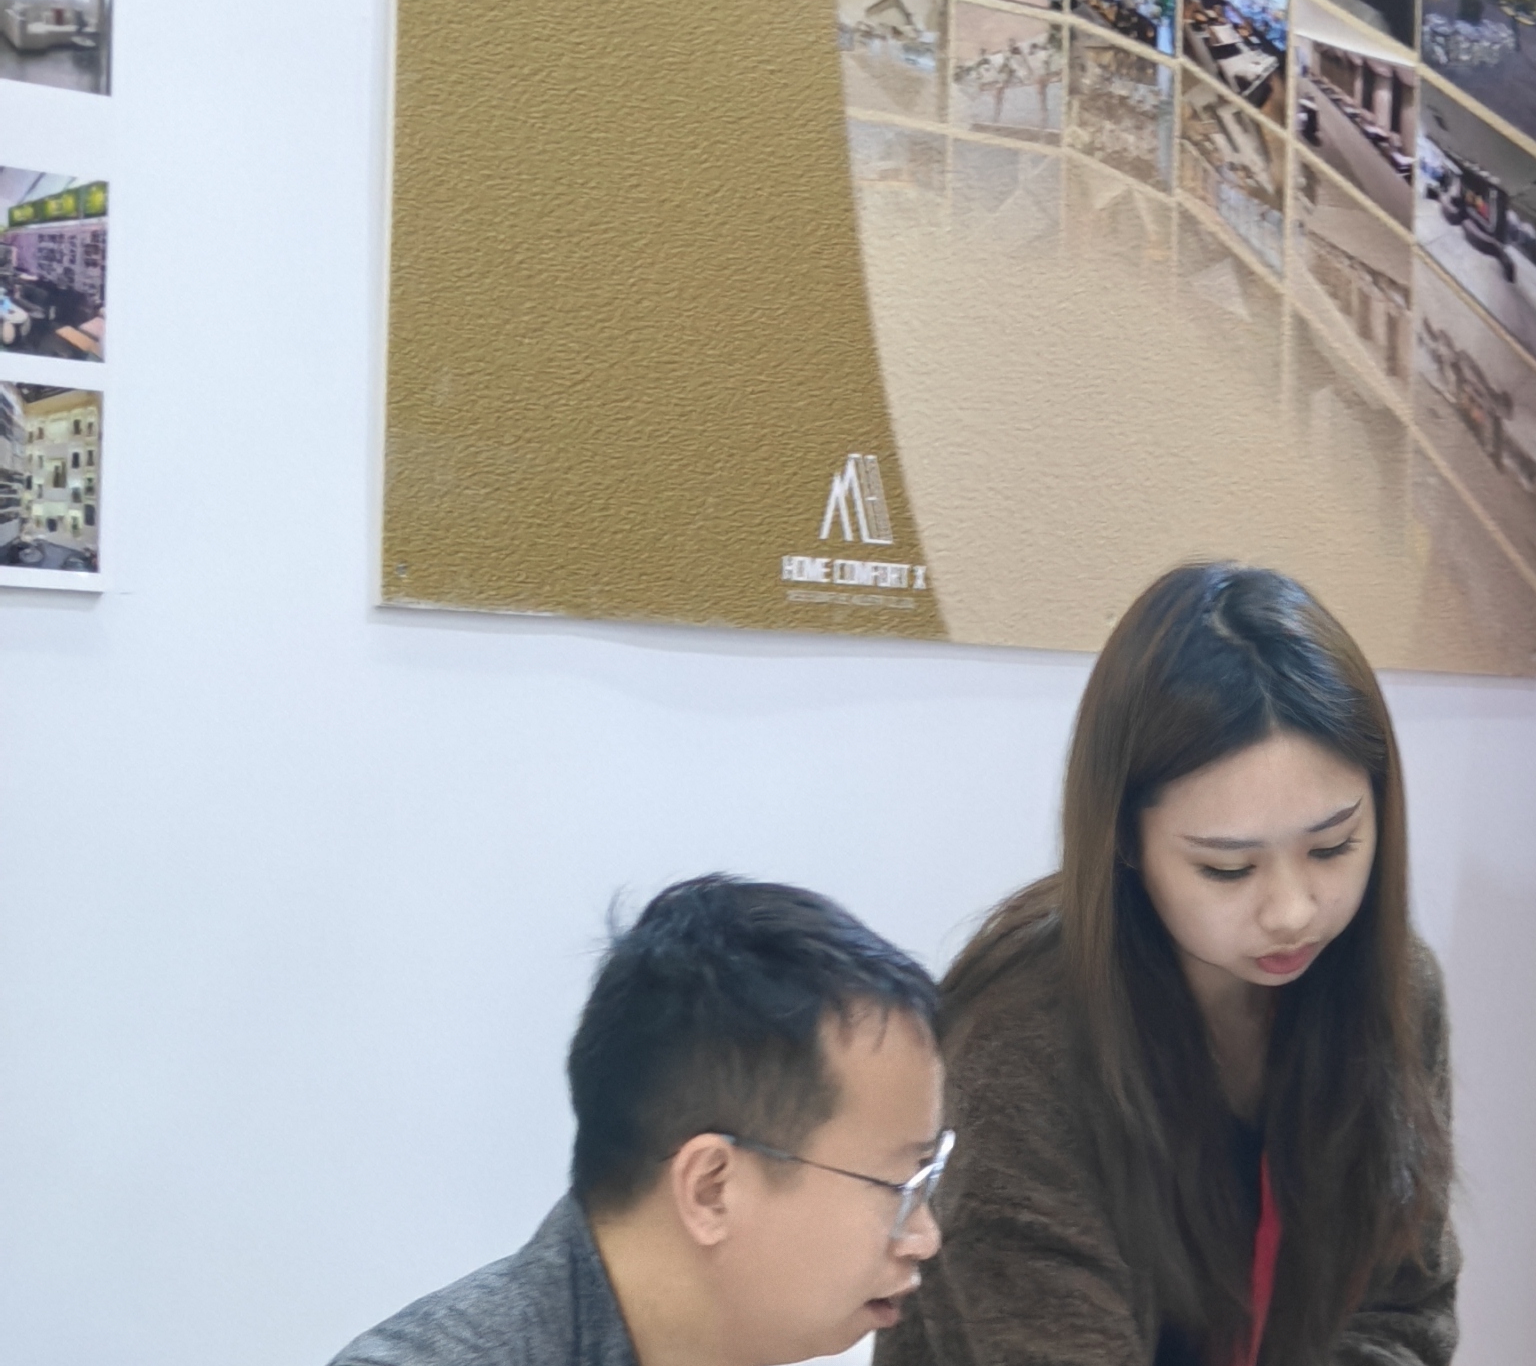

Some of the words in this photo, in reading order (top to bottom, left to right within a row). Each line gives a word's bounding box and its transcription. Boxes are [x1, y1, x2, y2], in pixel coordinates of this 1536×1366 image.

[781, 555, 832, 583] HOME
[832, 559, 911, 589] COMFORT
[912, 565, 928, 590] X
